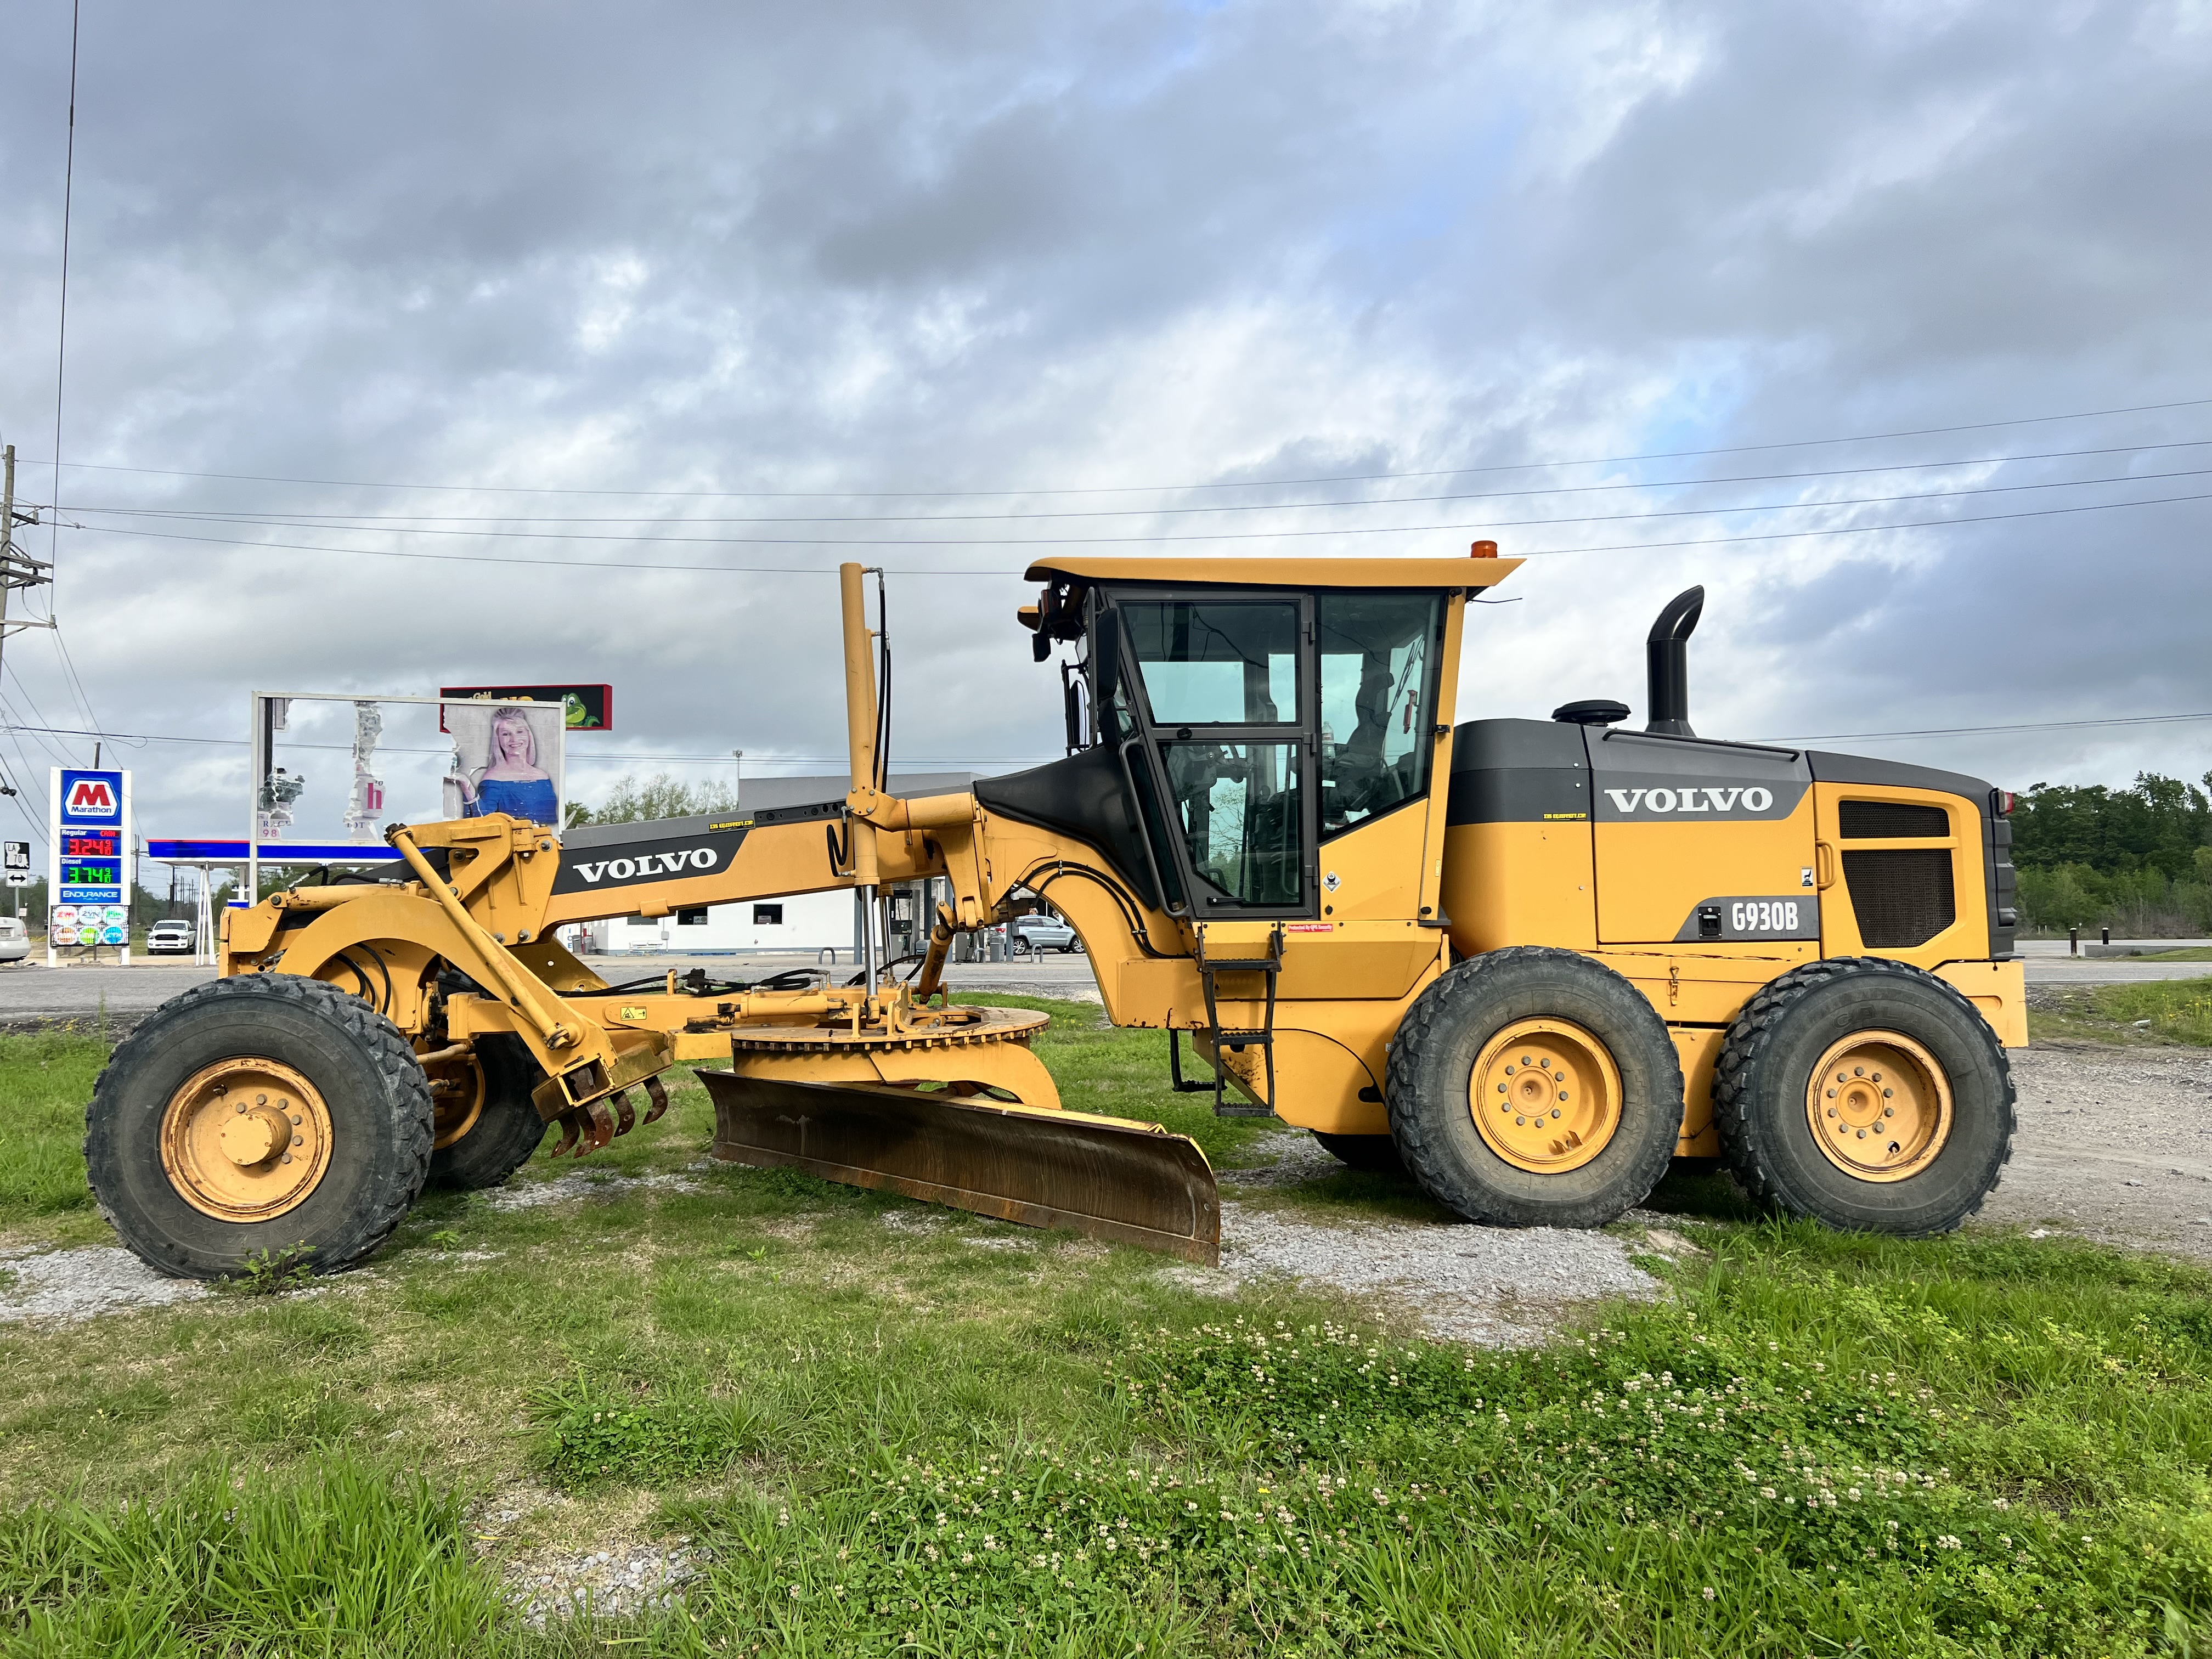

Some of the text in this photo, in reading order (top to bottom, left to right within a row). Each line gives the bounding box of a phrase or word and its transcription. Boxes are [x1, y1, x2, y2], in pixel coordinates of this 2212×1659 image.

[1604, 787, 1773, 812] VOLVO
[14, 854, 22, 864] 70
[572, 848, 718, 883] VOLVO
[1731, 901, 1798, 931] G930B
